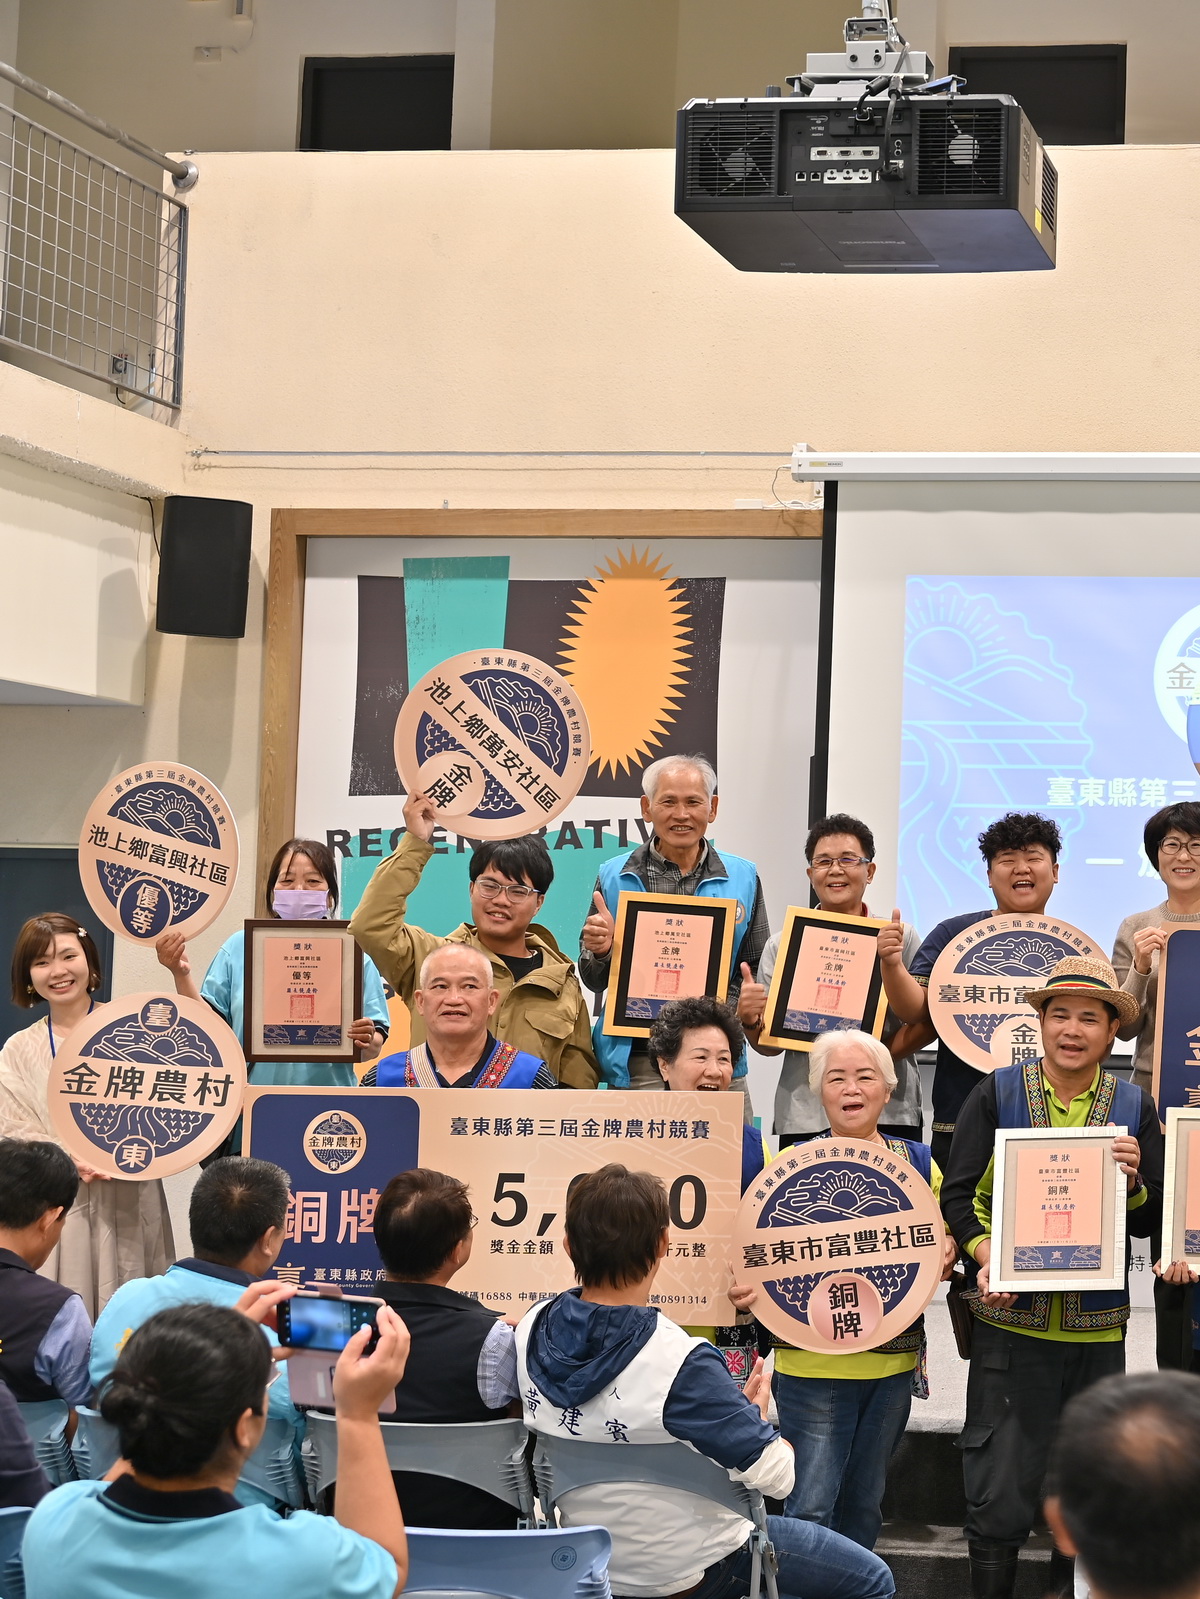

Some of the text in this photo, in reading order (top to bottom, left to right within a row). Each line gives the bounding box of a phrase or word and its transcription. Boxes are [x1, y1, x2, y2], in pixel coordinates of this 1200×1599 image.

[479, 656, 582, 757] 臺東縣第三屆金牌農村競賽
[424, 676, 562, 813] 池上鄉萬安社區
[114, 769, 227, 827] 臺東縣第三屆金牌農村競賽
[423, 762, 473, 809] 金牌
[87, 823, 230, 886] 池上鄉富興社區
[130, 882, 162, 935] 優等
[664, 917, 685, 927] 獎狀
[293, 942, 313, 951] 獎狀
[660, 945, 681, 956] 金牌
[830, 934, 850, 945] 獎狀
[954, 919, 1094, 957] 臺東縣第三屆金牌農村競賽
[291, 970, 312, 981] 優等
[824, 961, 844, 973] 金牌
[938, 983, 1045, 1005] 臺東市富
[144, 1002, 174, 1028] 臺
[59, 1061, 235, 1108] 金牌農村
[449, 1115, 711, 1141] 臺東縣第三屆金牌農村競賽
[307, 1135, 363, 1149] 金牌農村
[118, 1143, 150, 1169] 東
[1049, 1153, 1071, 1163] 獎狀
[754, 1146, 910, 1202] 臺東縣第三屆金牌農村競賽
[1047, 1184, 1069, 1196] 銅牌
[489, 1239, 554, 1256] 獎金金額
[742, 1222, 937, 1269] 臺東市富豐社區
[313, 1267, 388, 1283] 臺東縣政府
[646, 1293, 708, 1305] 號0891314
[827, 1281, 863, 1341] 銅牌
[524, 1386, 630, 1444] 黃建賓
